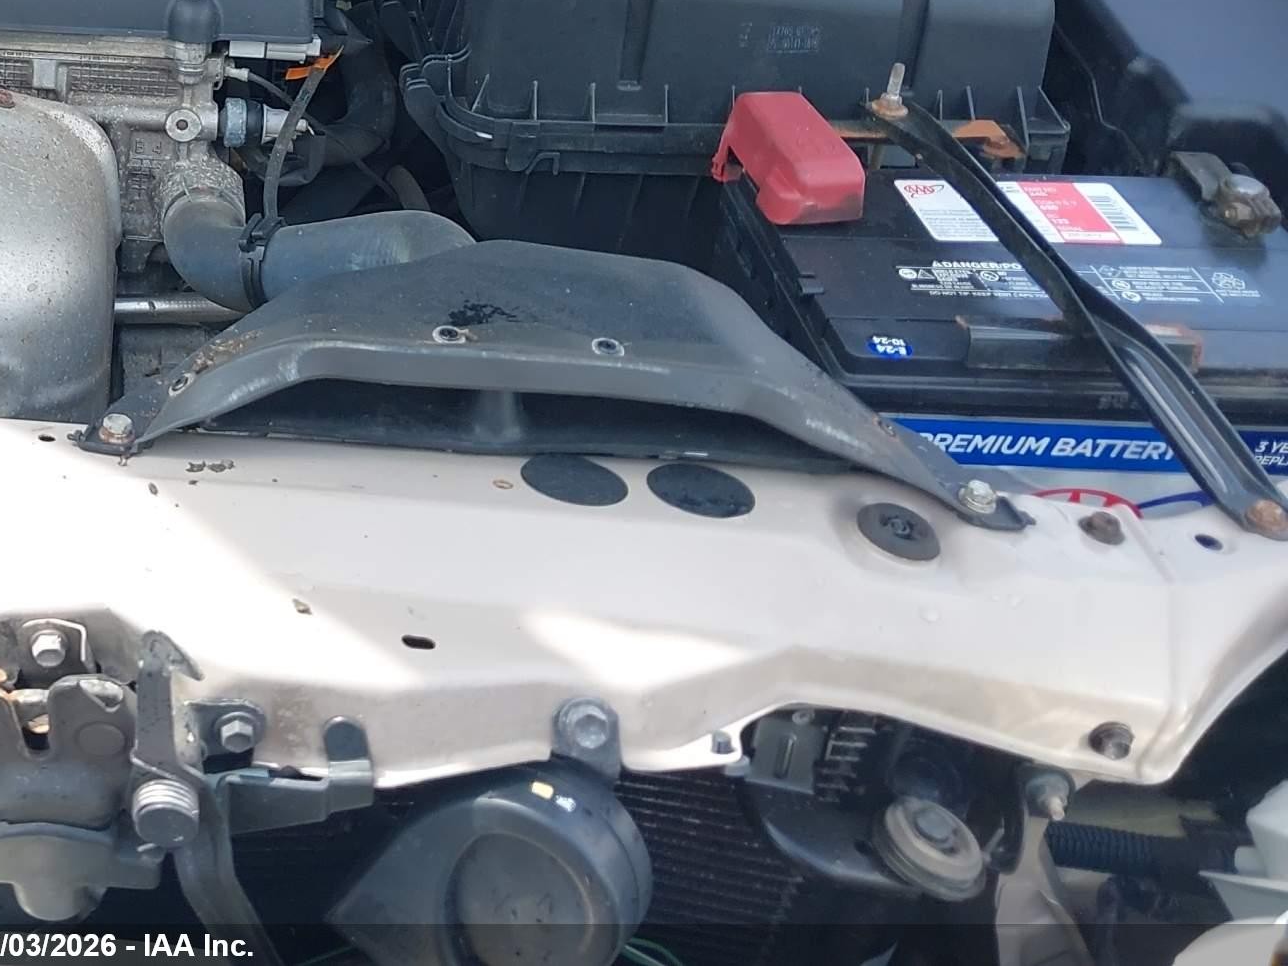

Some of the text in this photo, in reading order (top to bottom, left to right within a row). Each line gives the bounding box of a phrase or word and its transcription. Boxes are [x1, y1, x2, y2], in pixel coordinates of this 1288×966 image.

[943, 261, 1022, 269] DANGER/PO
[1255, 441, 1269, 453] 3
[1255, 455, 1288, 466] REPL
